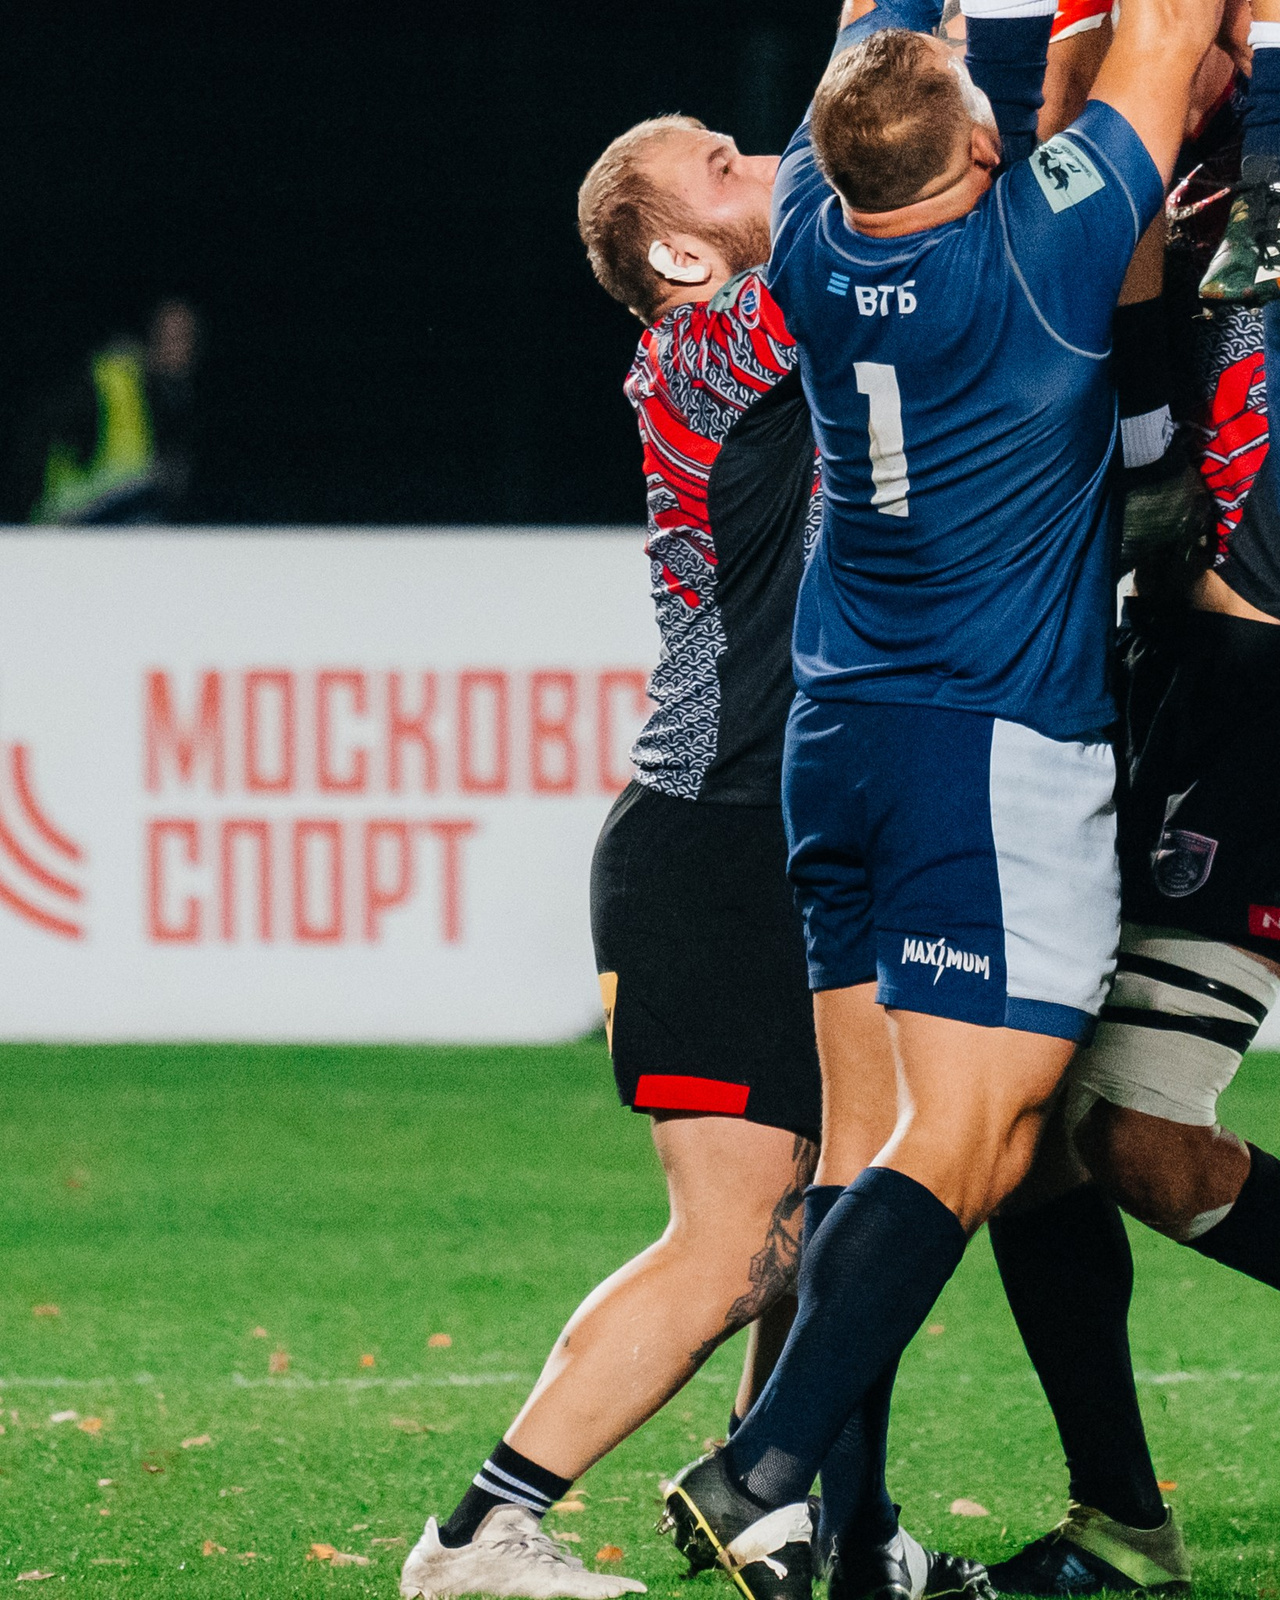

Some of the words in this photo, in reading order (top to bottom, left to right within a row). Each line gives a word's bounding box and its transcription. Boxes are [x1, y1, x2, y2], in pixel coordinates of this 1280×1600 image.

[855, 280, 917, 316] ВТБ
[853, 361, 910, 517] 1
[146, 817, 478, 946] СПОРТ
